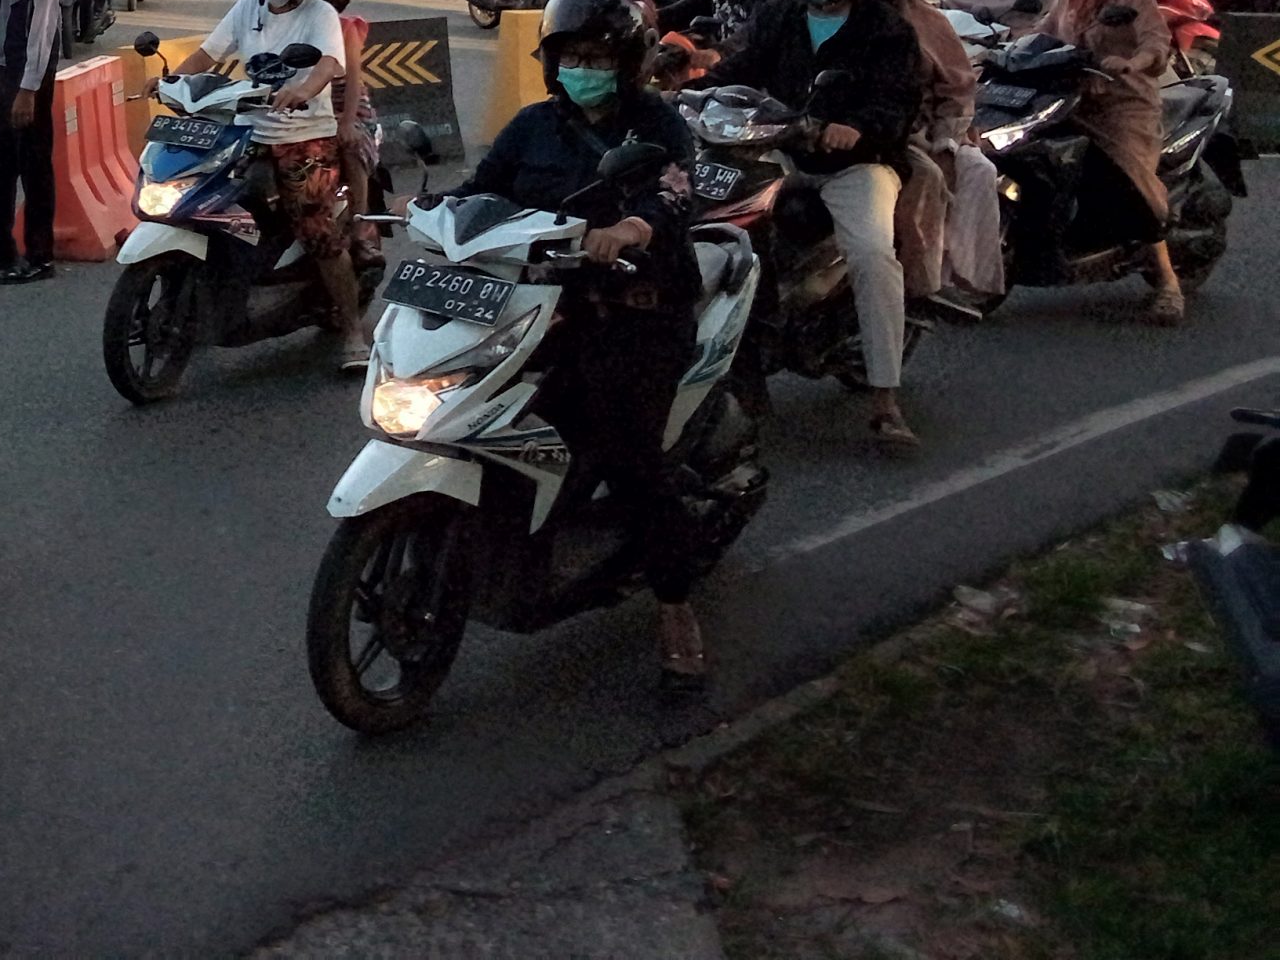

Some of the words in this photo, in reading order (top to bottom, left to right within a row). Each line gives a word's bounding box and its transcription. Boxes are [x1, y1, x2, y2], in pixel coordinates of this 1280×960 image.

[153, 117, 170, 130] BP
[171, 121, 199, 133] 3415
[714, 168, 737, 184] WH
[400, 265, 426, 283] BP
[425, 271, 474, 296] 2460
